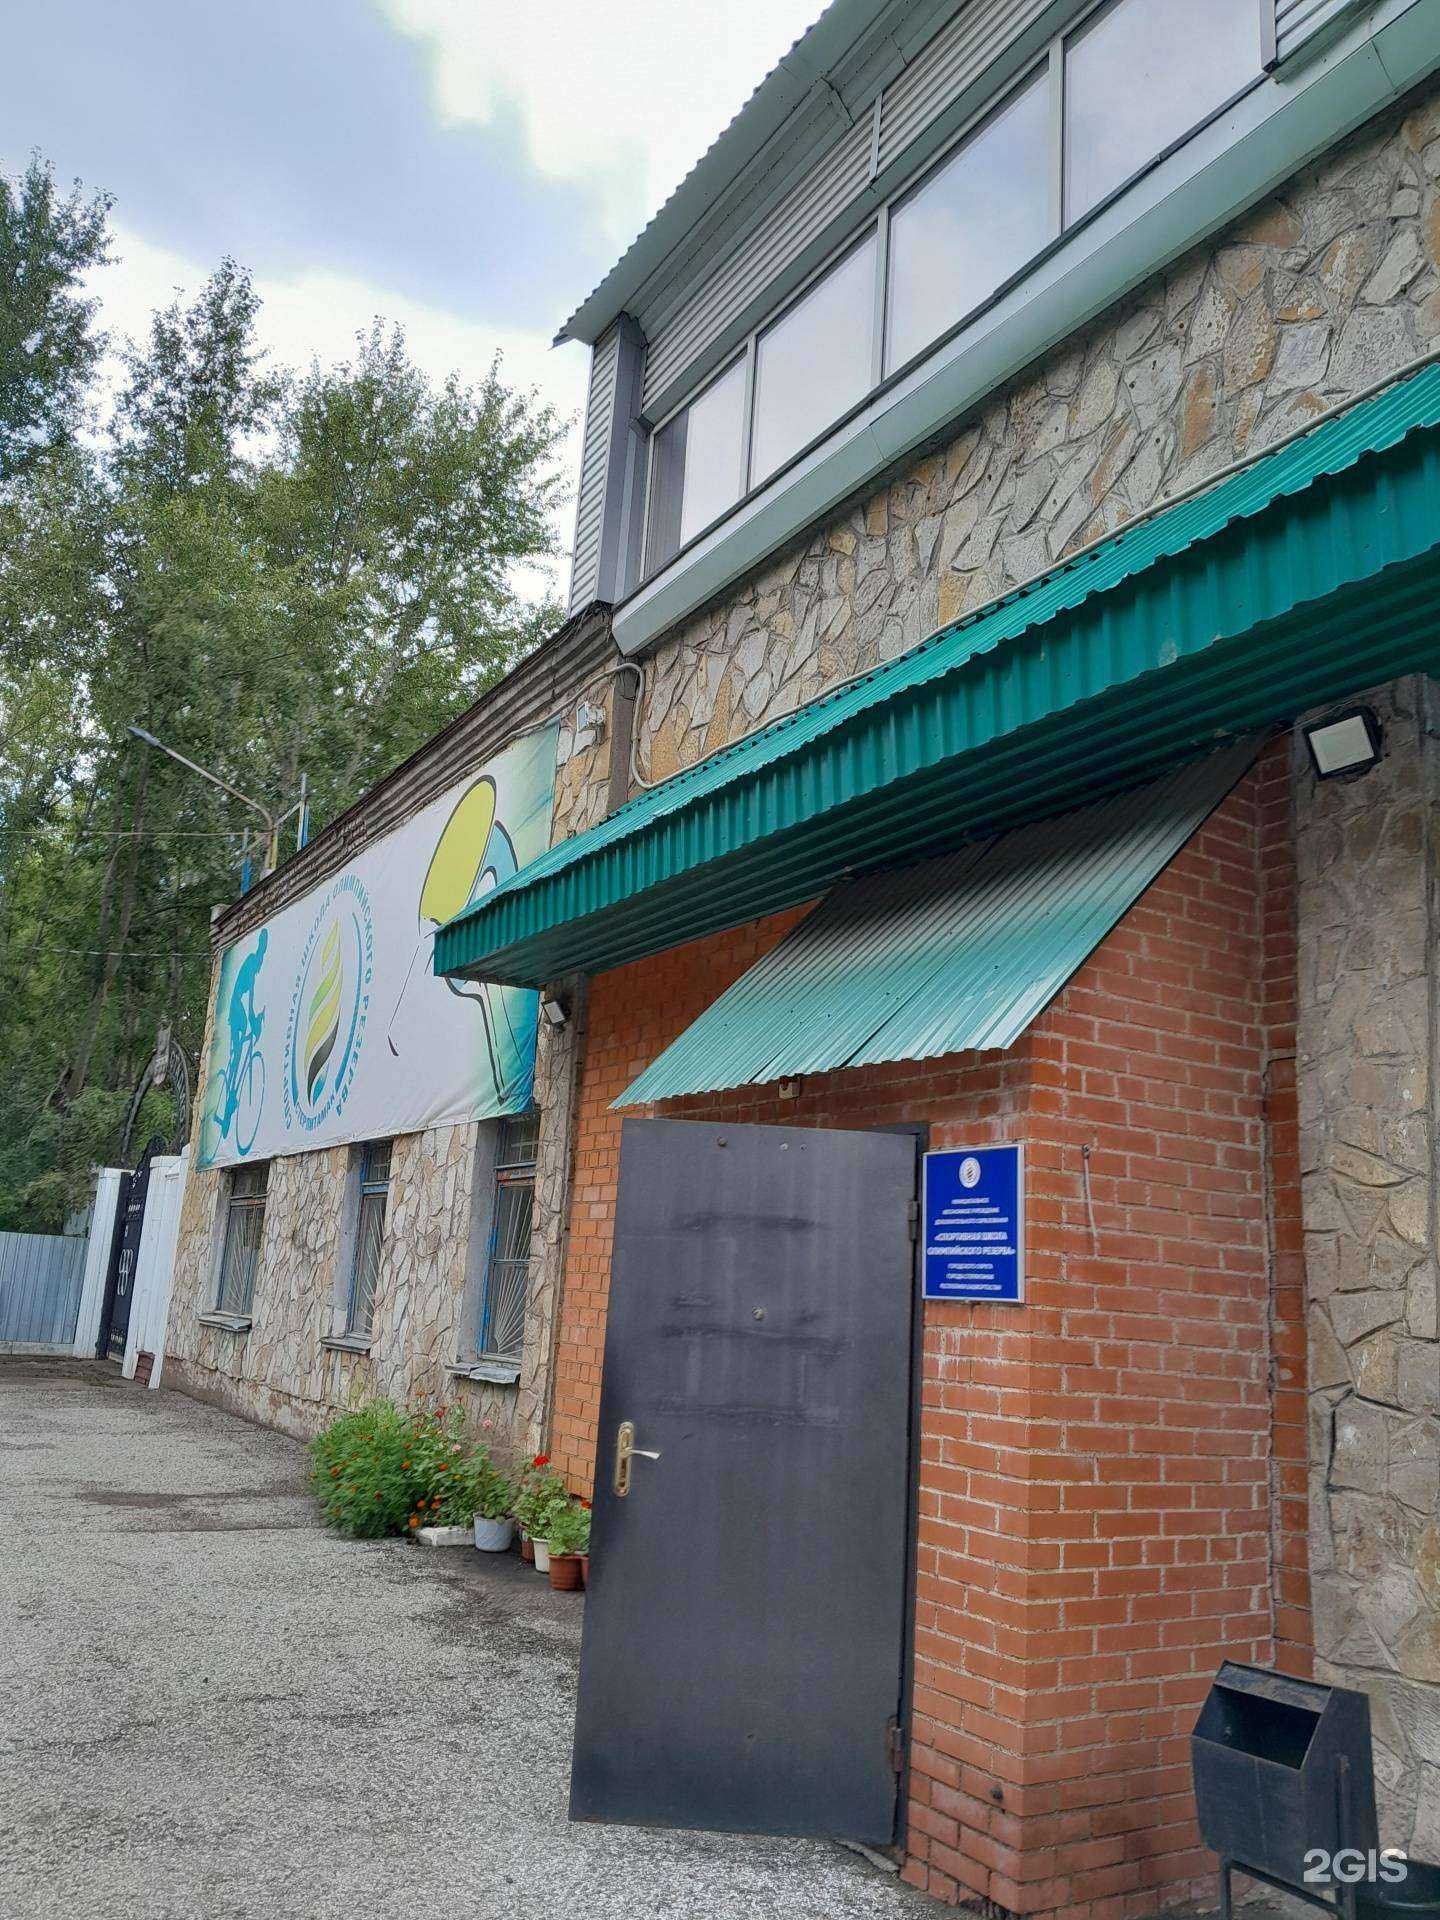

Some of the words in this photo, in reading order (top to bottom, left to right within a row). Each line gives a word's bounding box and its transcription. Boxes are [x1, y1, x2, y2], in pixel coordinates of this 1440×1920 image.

[301, 895, 331, 967] ШКОЛА
[332, 875, 373, 984] ОЛИМПИЙСКОГО
[336, 995, 369, 1116] РЕЗЕРВА
